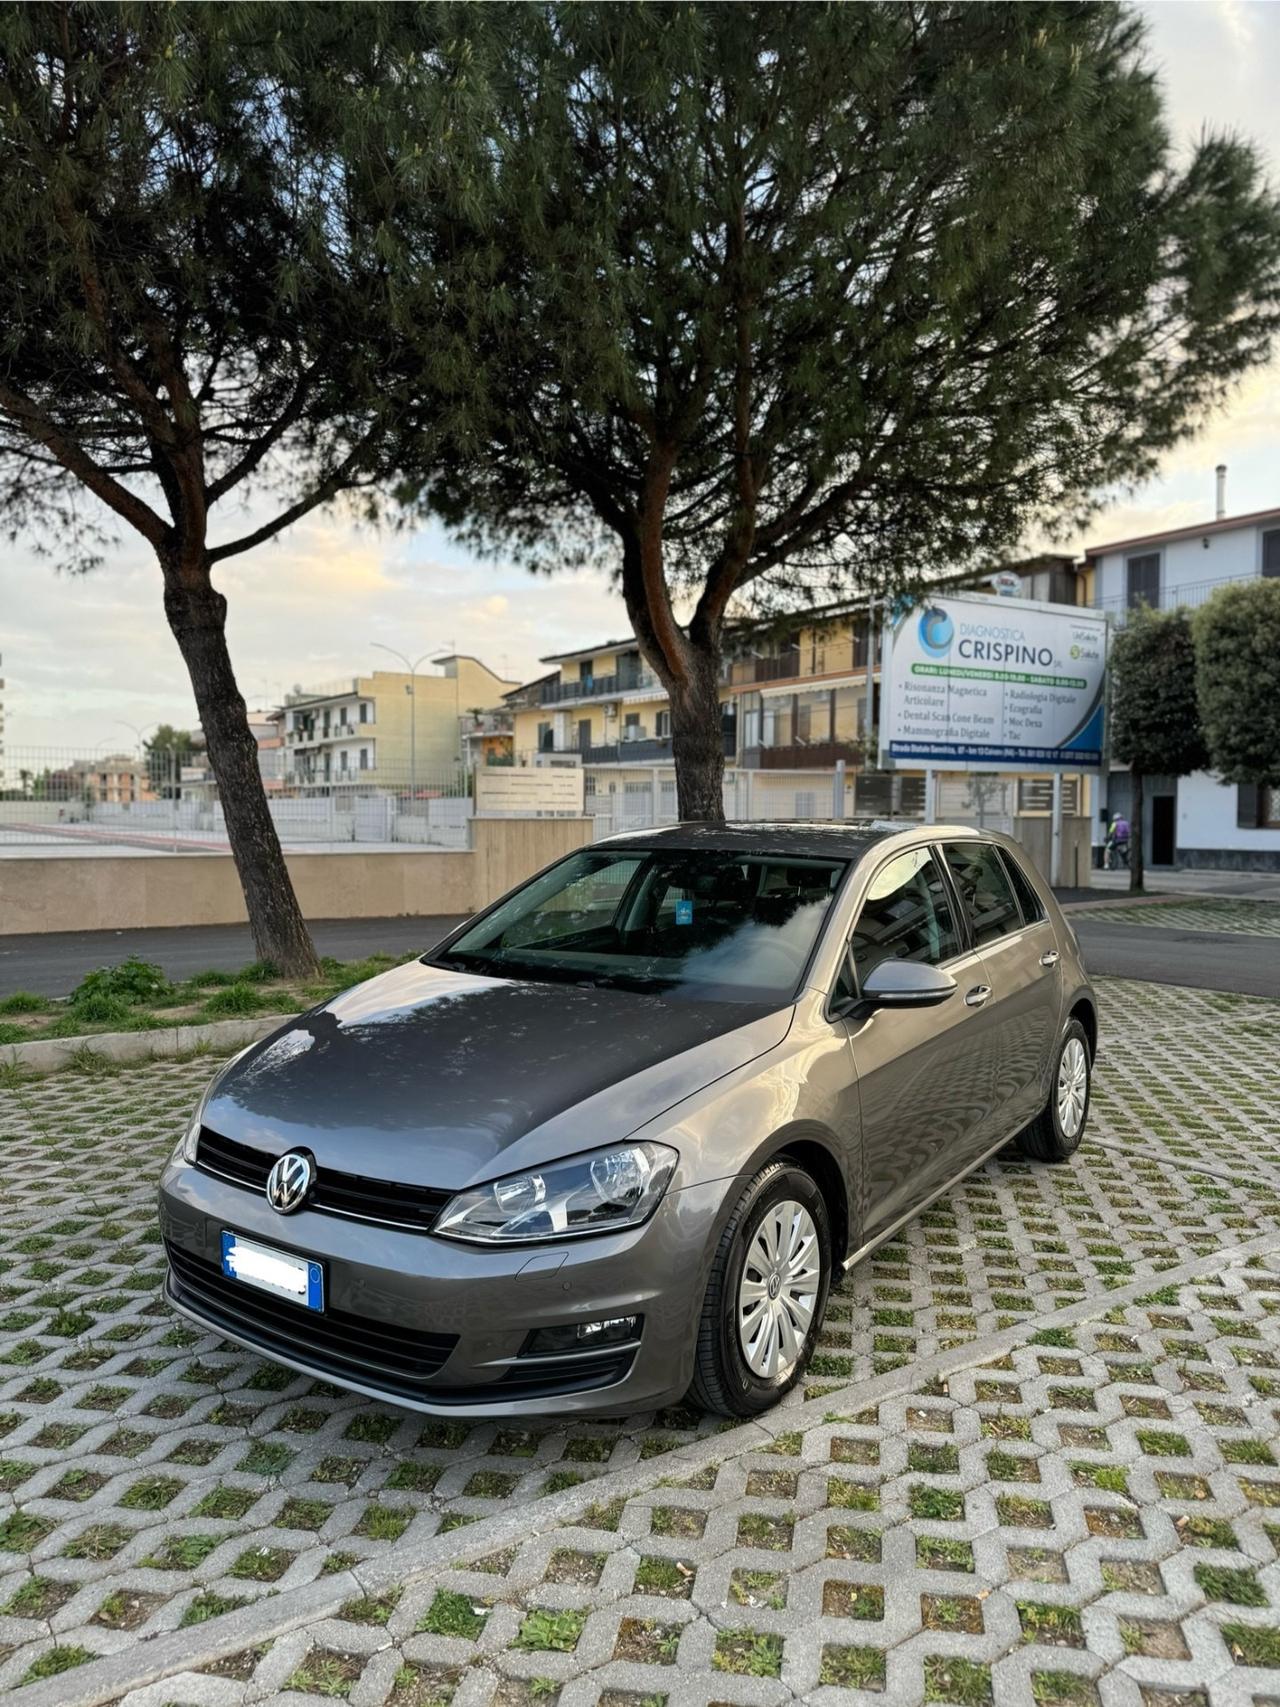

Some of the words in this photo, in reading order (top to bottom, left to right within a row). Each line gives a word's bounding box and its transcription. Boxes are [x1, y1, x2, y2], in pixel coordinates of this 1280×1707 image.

[960, 623, 1026, 641] DIAGNOSTICA
[958, 639, 1053, 666] CRISPINO
[904, 682, 945, 694] Risonanza
[947, 684, 987, 697] Magnetica
[904, 695, 945, 707] Articolare
[1010, 690, 1048, 703] Radiologia
[1049, 693, 1077, 705] Digitale
[1009, 704, 1042, 715] Ecografia
[904, 710, 930, 721] Dental
[931, 712, 950, 722] Scan
[952, 713, 972, 723] Cone
[973, 713, 994, 724] Beam
[903, 725, 959, 738] Mammografia
[960, 727, 990, 739] Digitale
[1008, 731, 1021, 740] Tac
